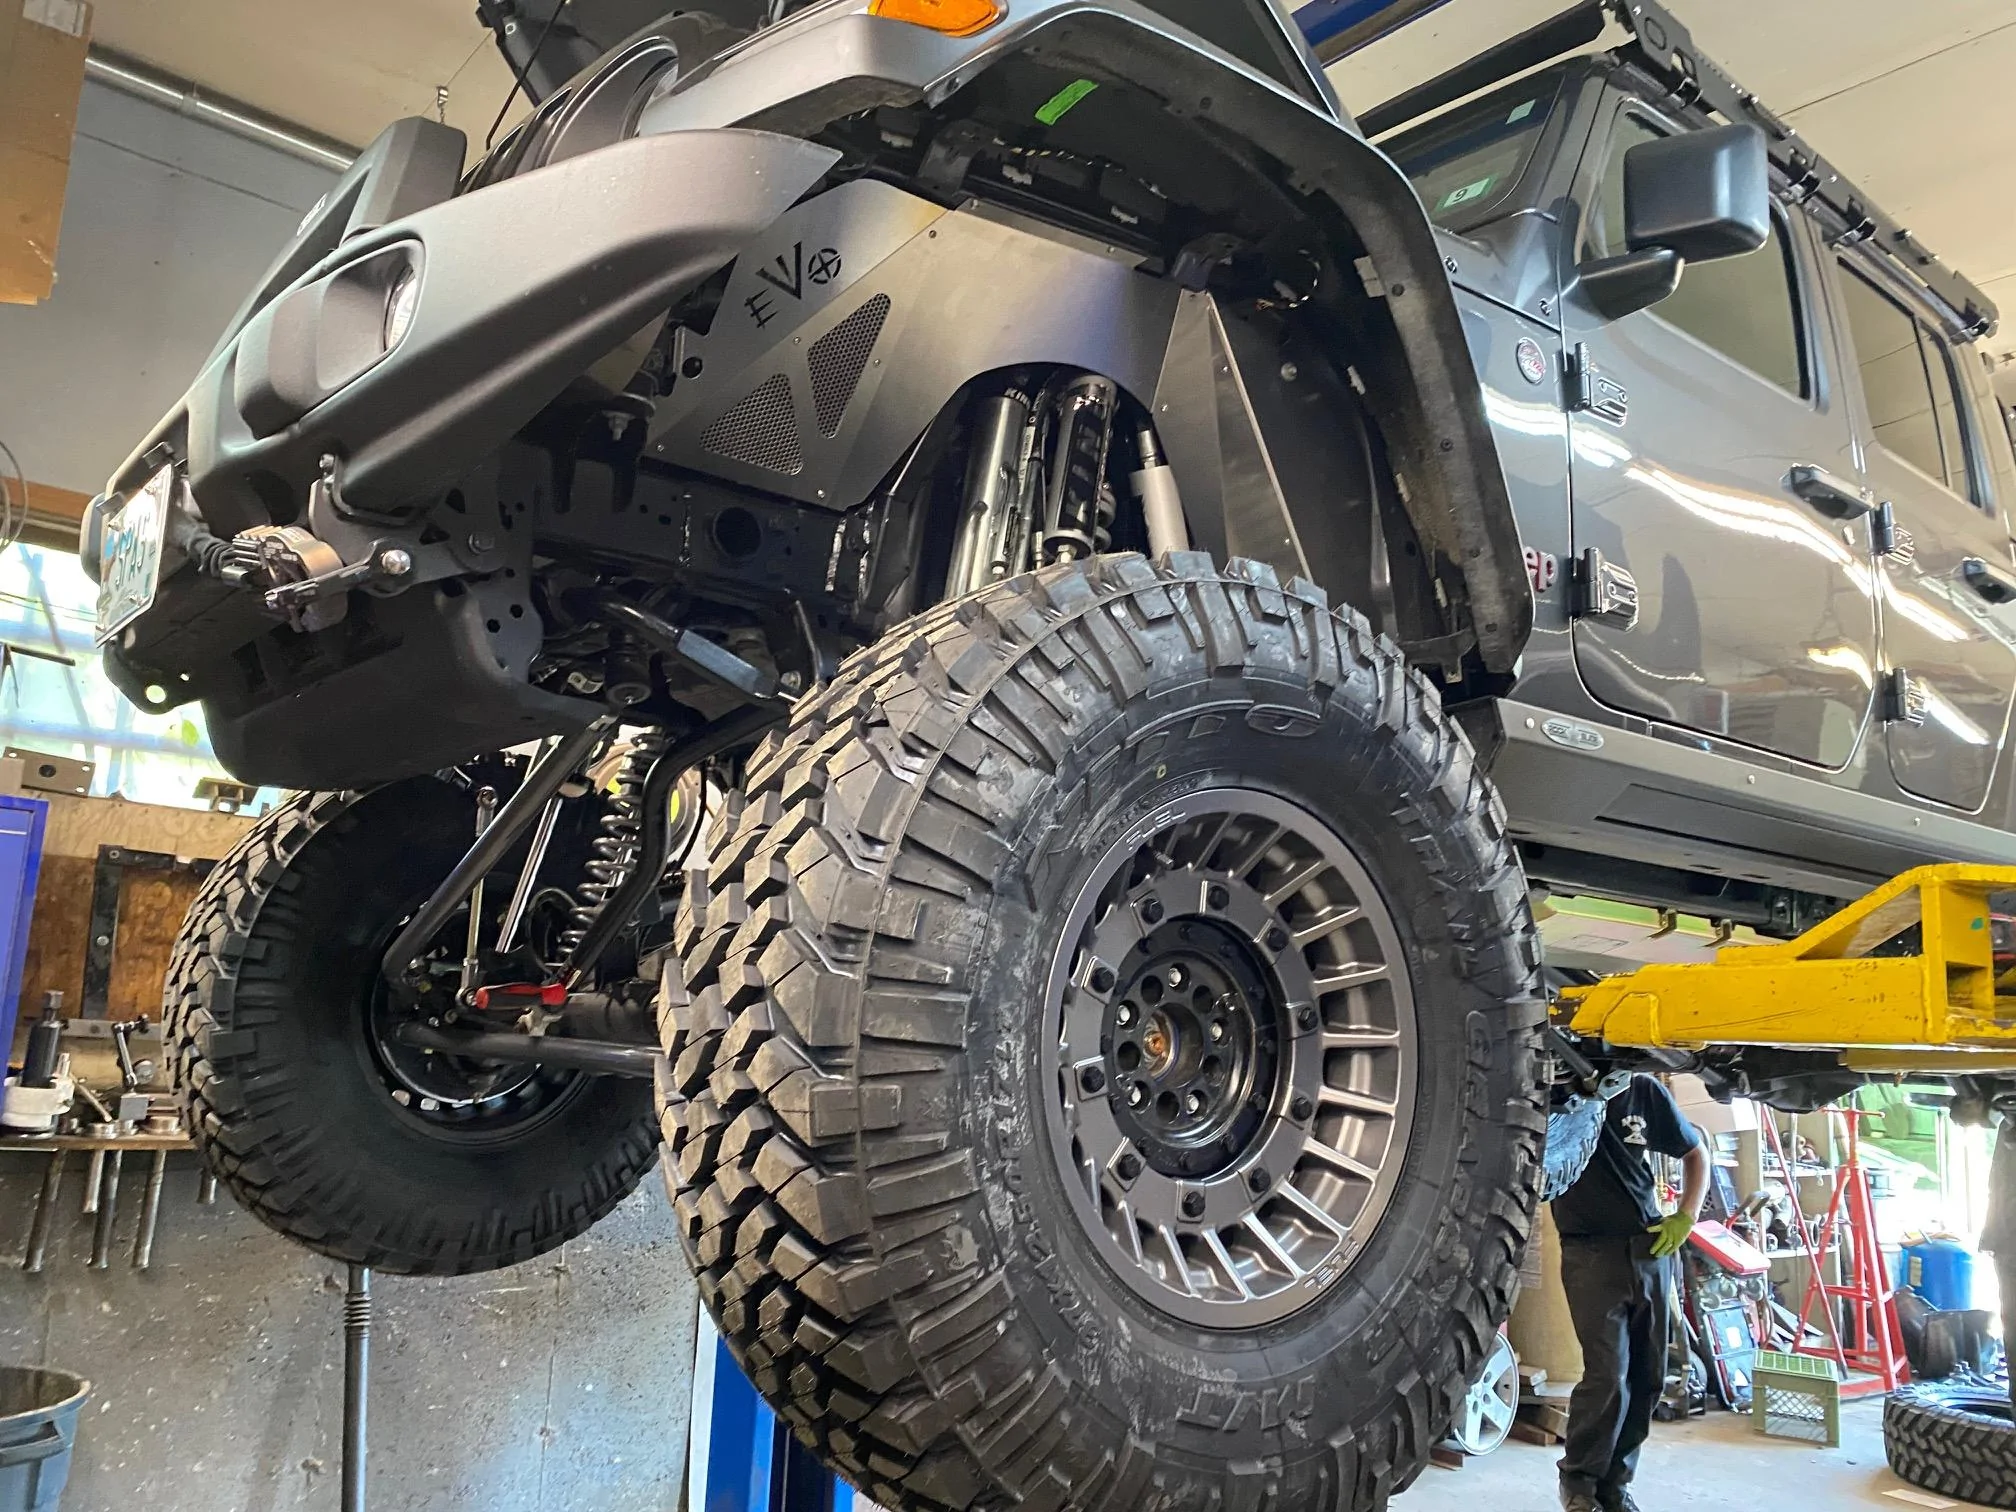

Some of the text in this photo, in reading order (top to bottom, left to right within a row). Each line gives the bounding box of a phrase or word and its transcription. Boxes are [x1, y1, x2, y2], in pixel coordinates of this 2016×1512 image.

[744, 241, 842, 329] EVO
[1522, 546, 1559, 592] ep
[1125, 807, 1186, 851] FUEL
[1304, 1239, 1360, 1289] FUEL
